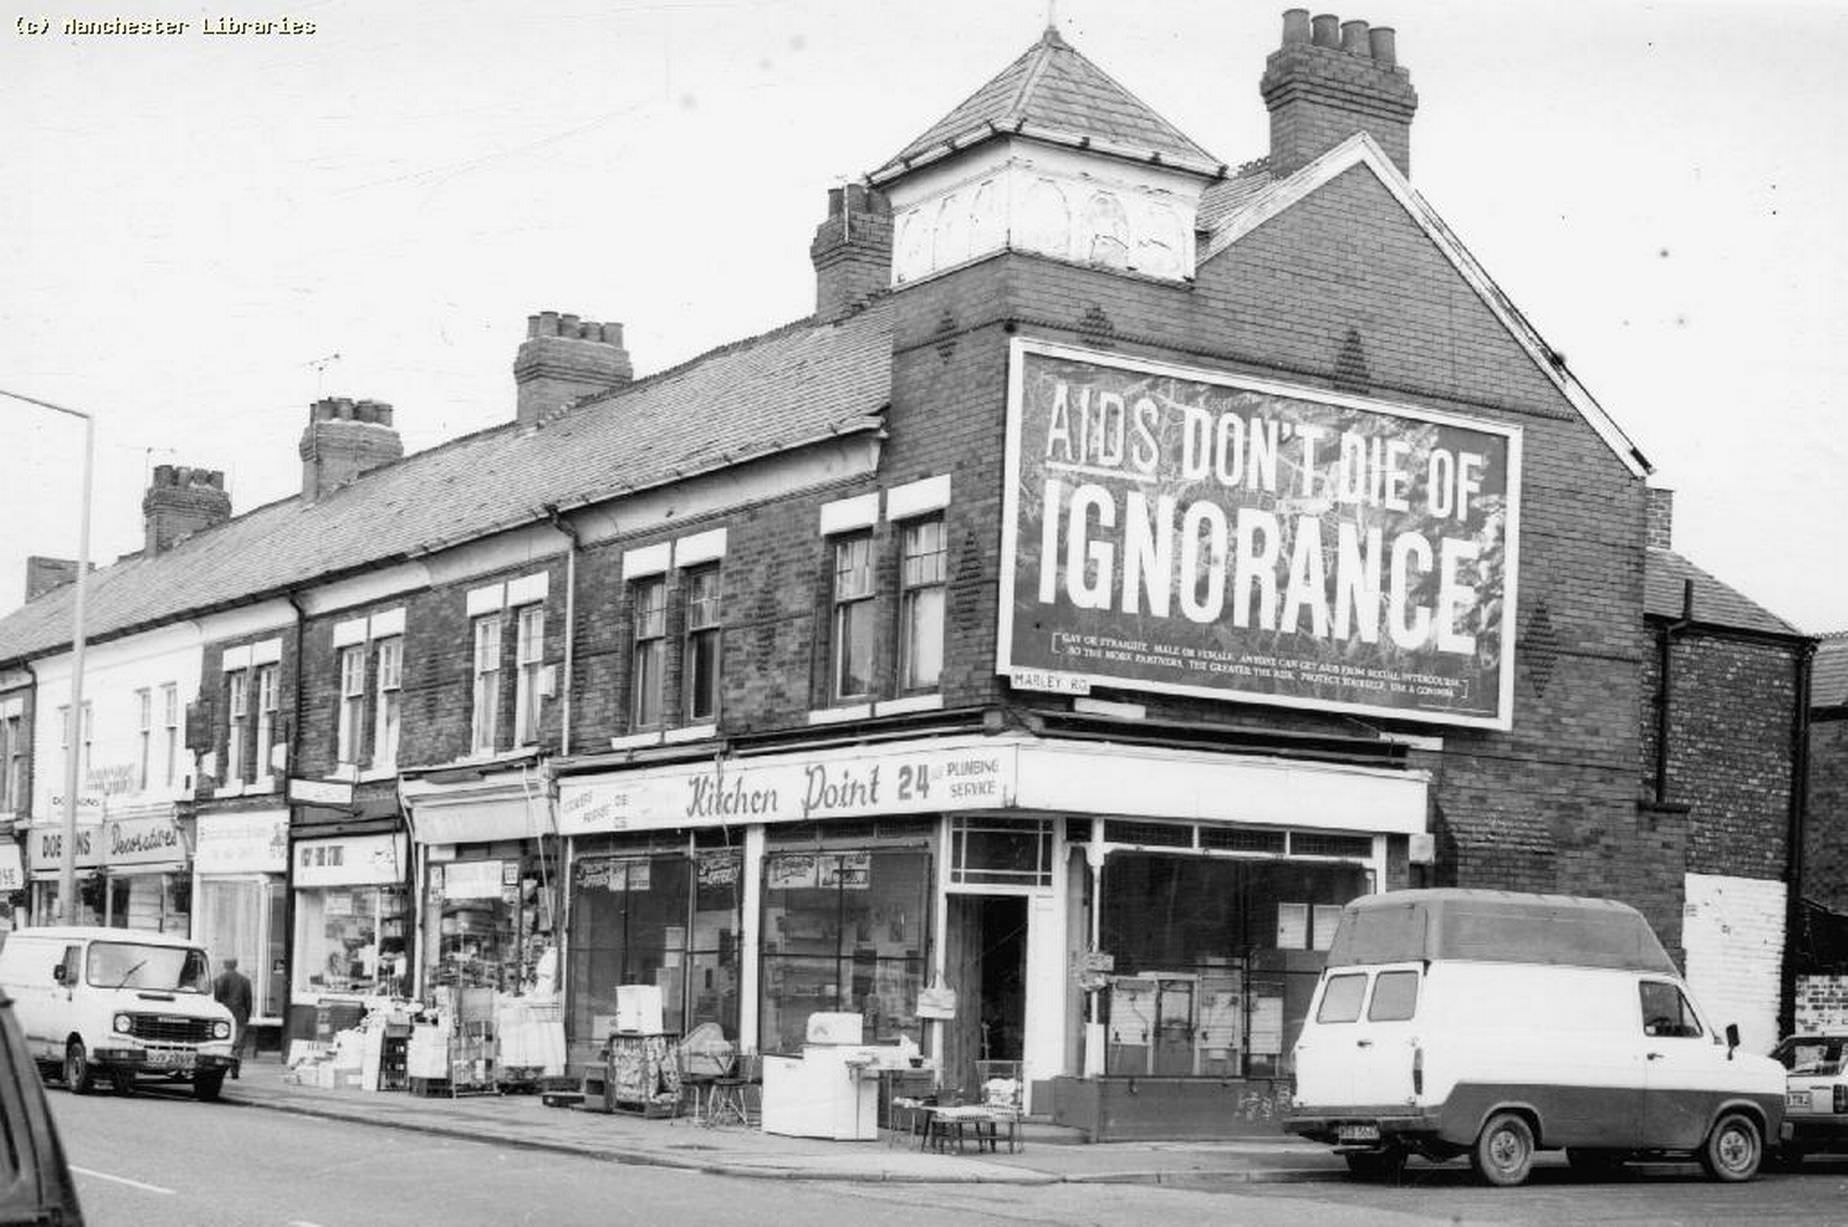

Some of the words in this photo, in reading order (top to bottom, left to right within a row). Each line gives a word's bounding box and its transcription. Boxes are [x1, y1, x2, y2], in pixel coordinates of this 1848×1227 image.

[1045, 380, 1160, 474] AIDS
[1182, 402, 1326, 498] DON'T
[1340, 429, 1412, 513] DIE
[1427, 447, 1483, 522] OF
[1037, 477, 1480, 656] IGNORANCE
[686, 775, 779, 818] Kitchen
[801, 763, 880, 820] Point
[898, 764, 930, 800] 24
[946, 758, 1000, 777] PLUMBING
[950, 780, 997, 799] SERVICE
